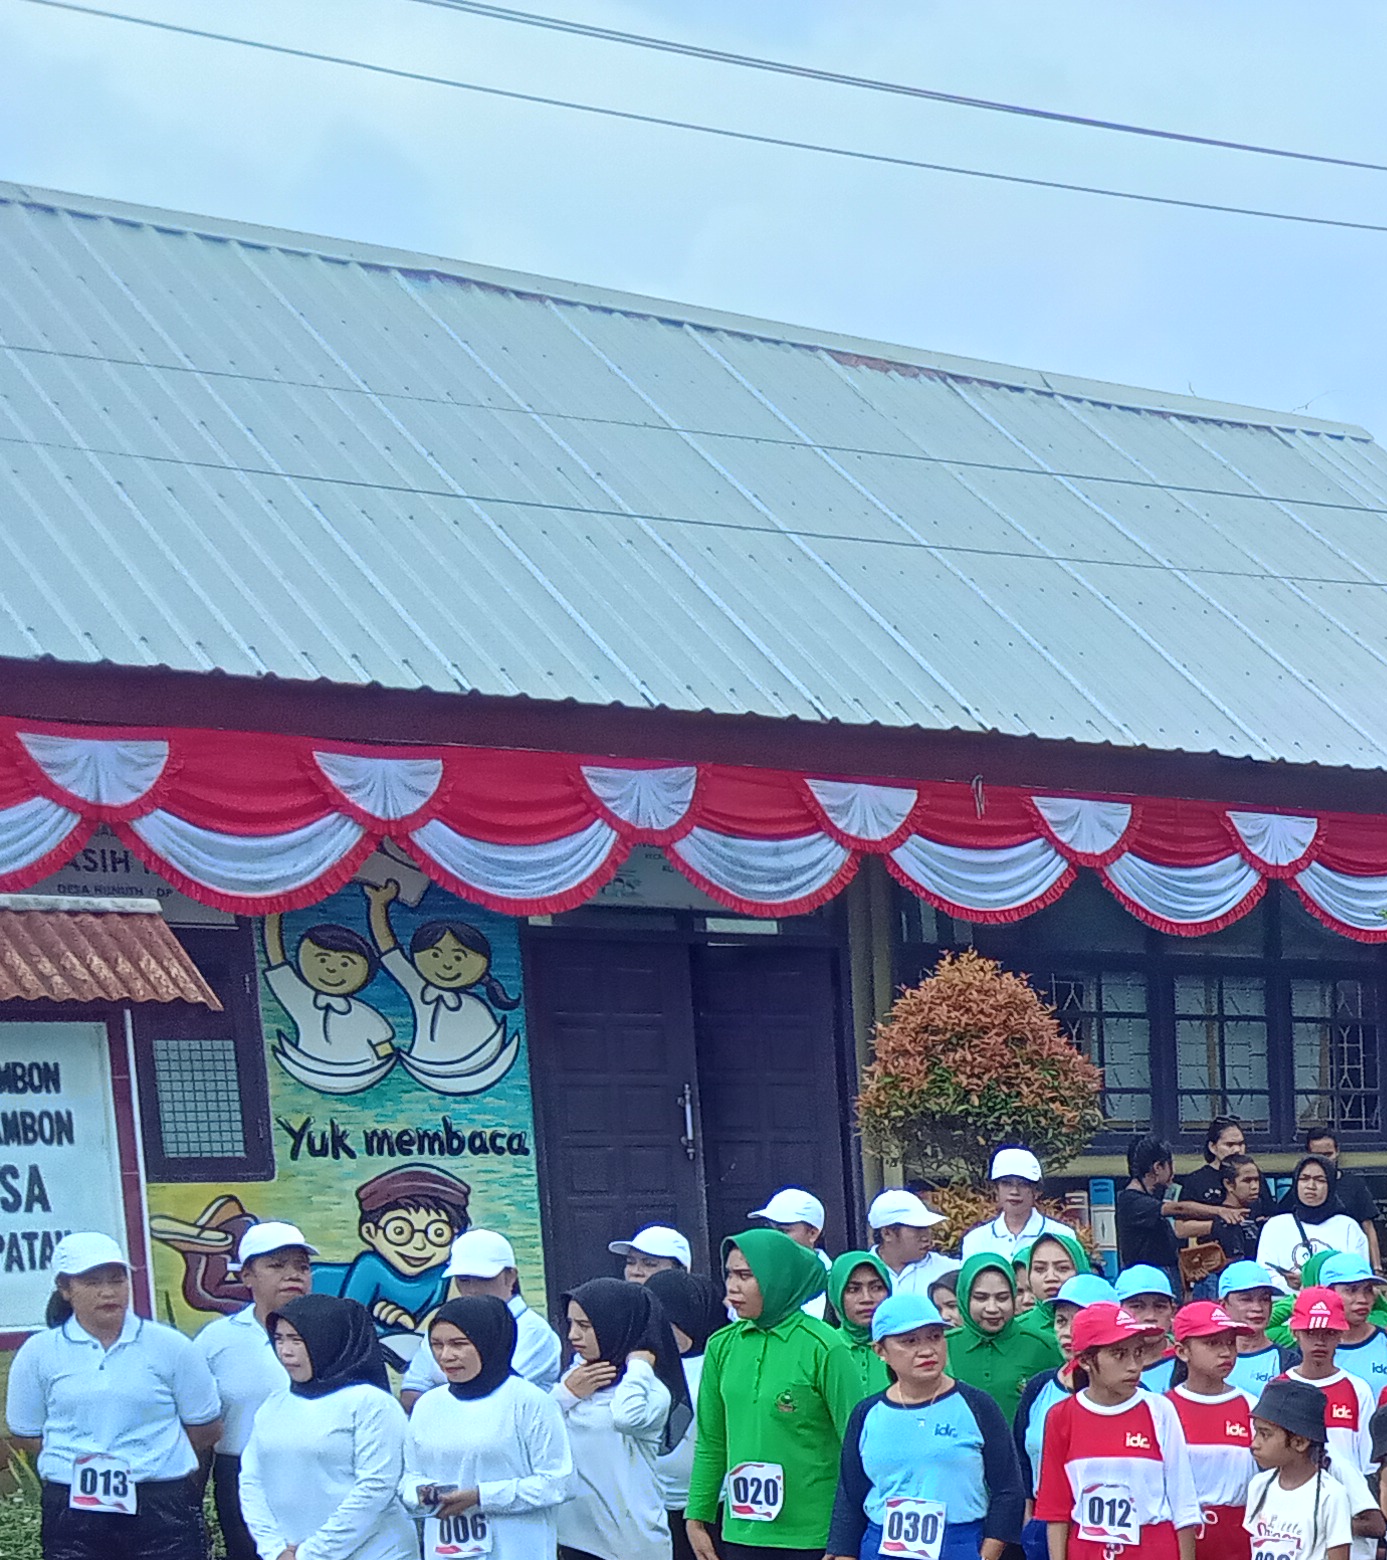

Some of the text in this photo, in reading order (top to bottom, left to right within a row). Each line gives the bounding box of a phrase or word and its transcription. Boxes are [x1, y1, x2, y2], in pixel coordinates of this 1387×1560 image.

[0, 1108, 75, 1147] MBON
[275, 1115, 530, 1161] Yuk membaca
[80, 1467, 129, 1498] 013
[733, 1476, 779, 1507] 020
[887, 1511, 939, 1544] 030
[1088, 1496, 1132, 1528] 012
[440, 1513, 487, 1545] 006
